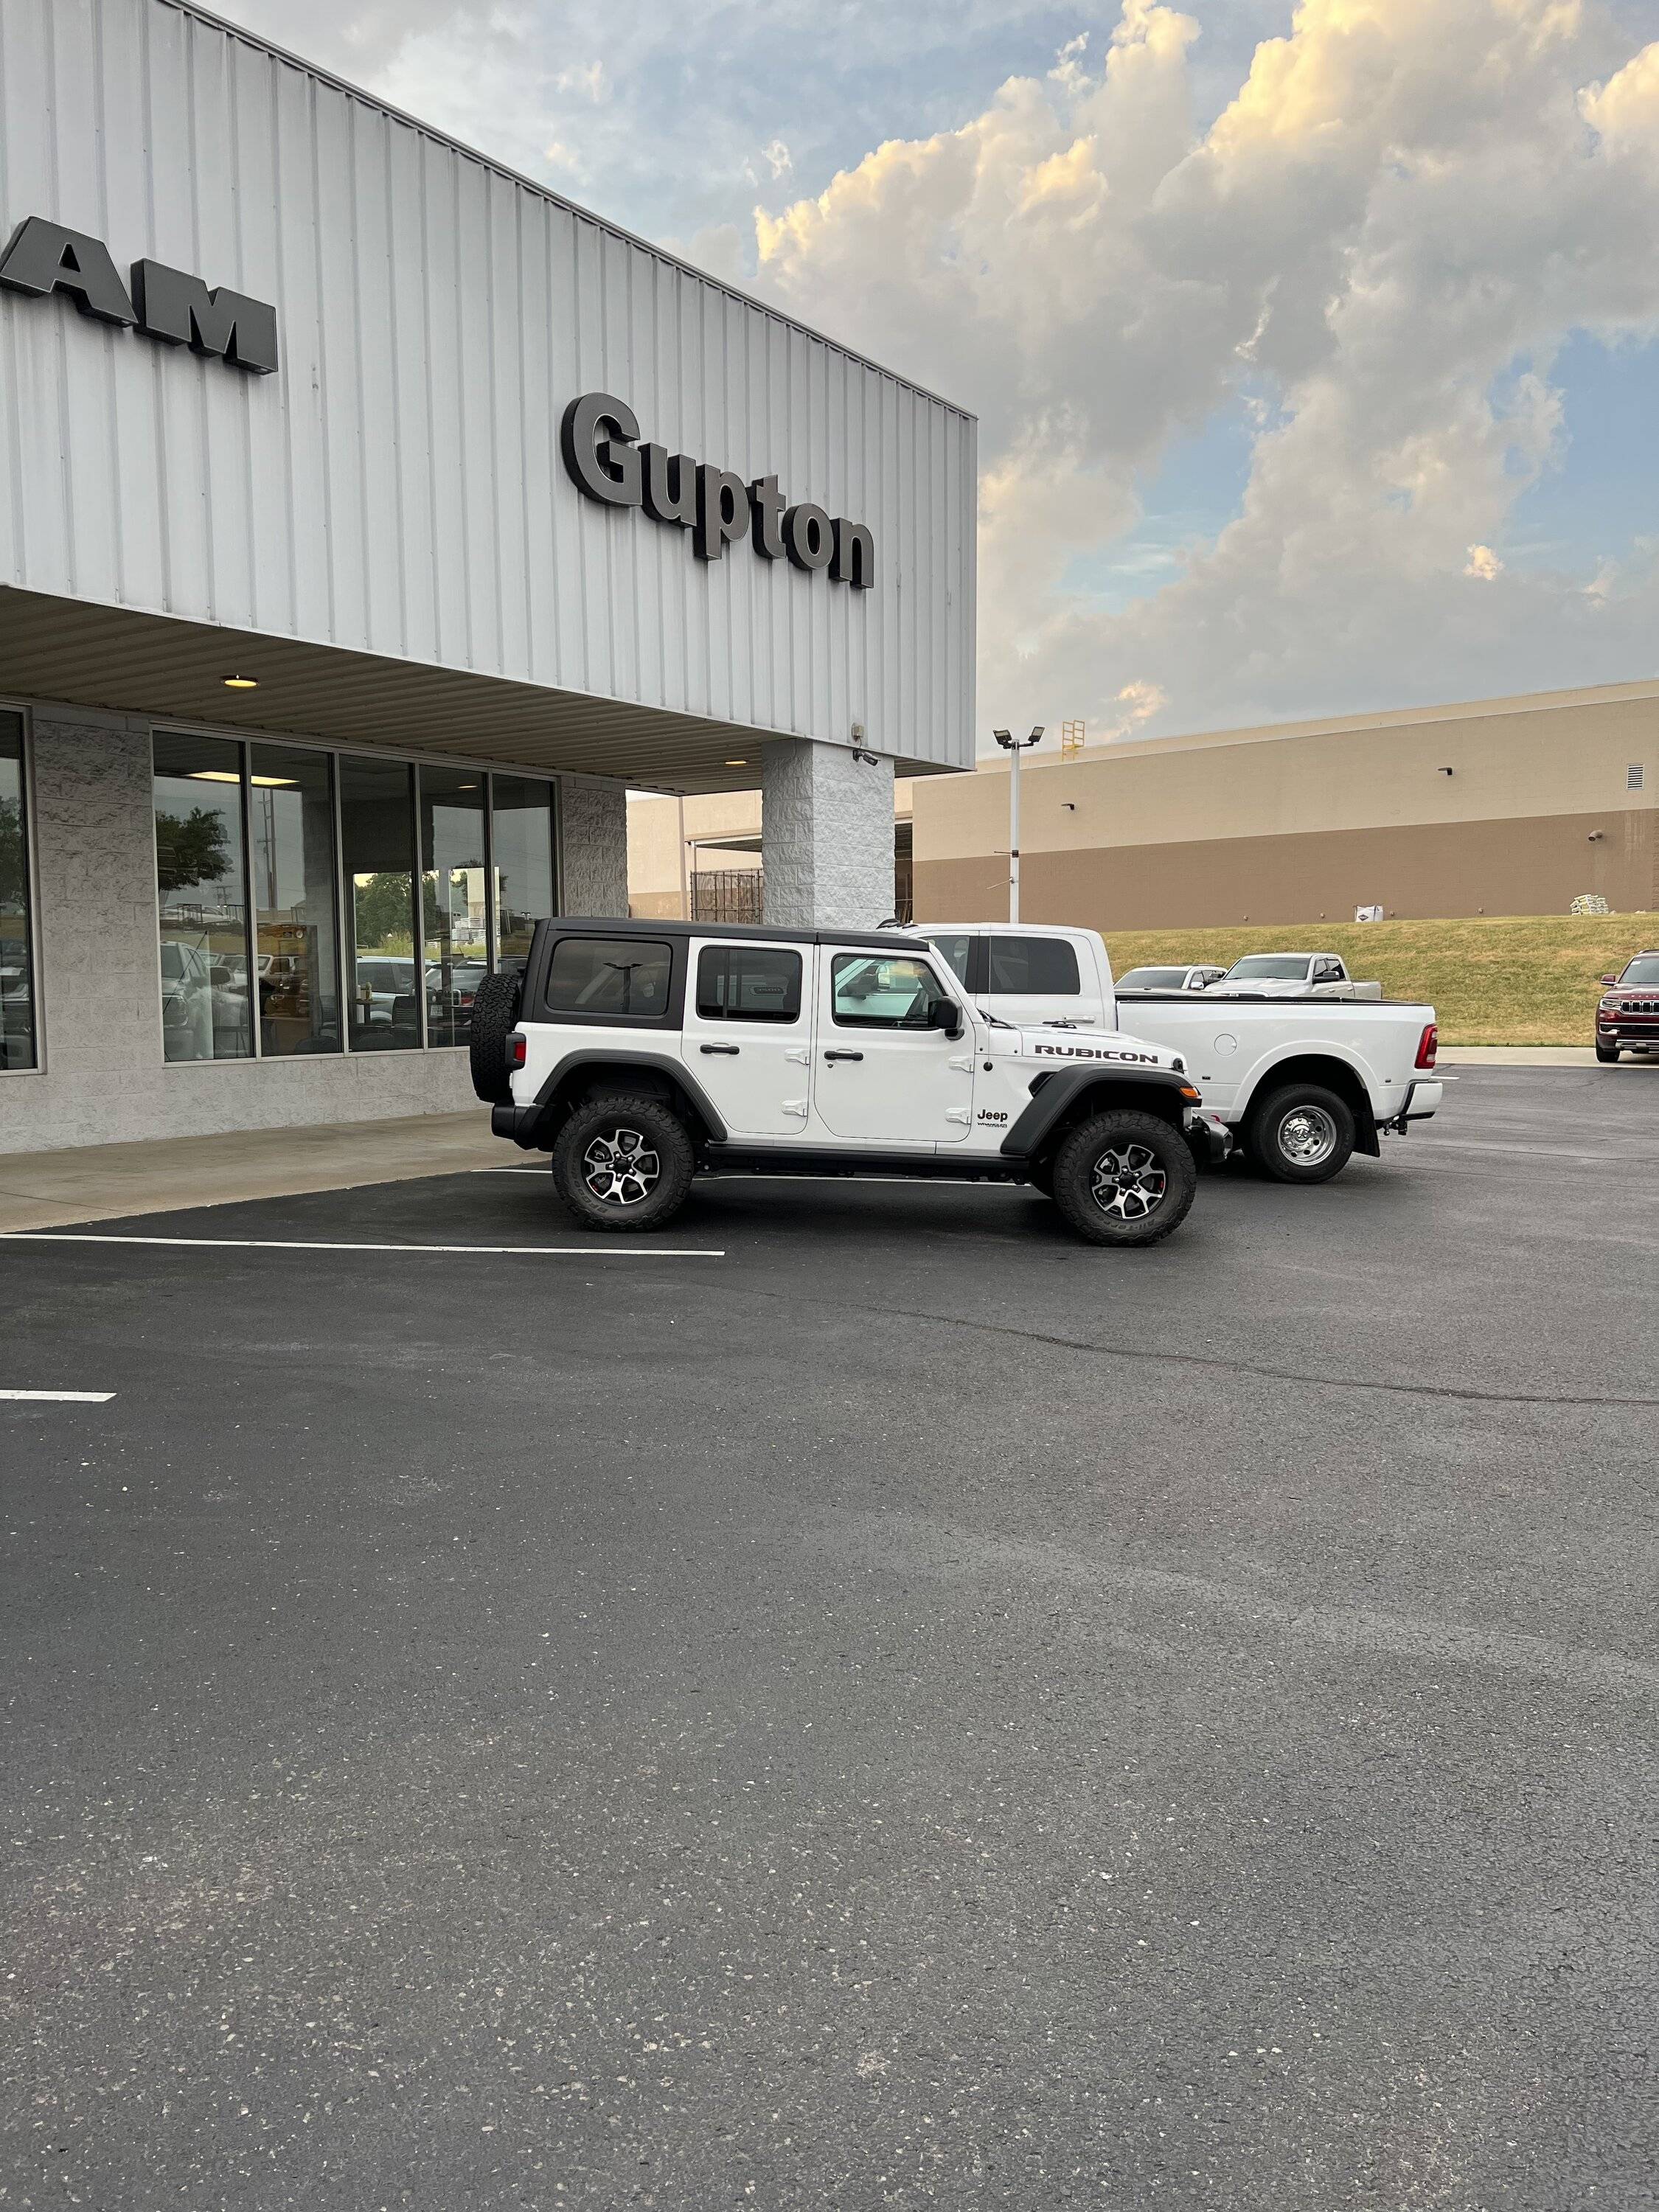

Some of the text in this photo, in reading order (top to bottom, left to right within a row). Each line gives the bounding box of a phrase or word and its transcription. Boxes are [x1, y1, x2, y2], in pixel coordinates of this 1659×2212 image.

[561, 392, 874, 589] Gupton
[1034, 1045, 1158, 1064] RUBICON
[977, 1109, 1008, 1122] Jeep
